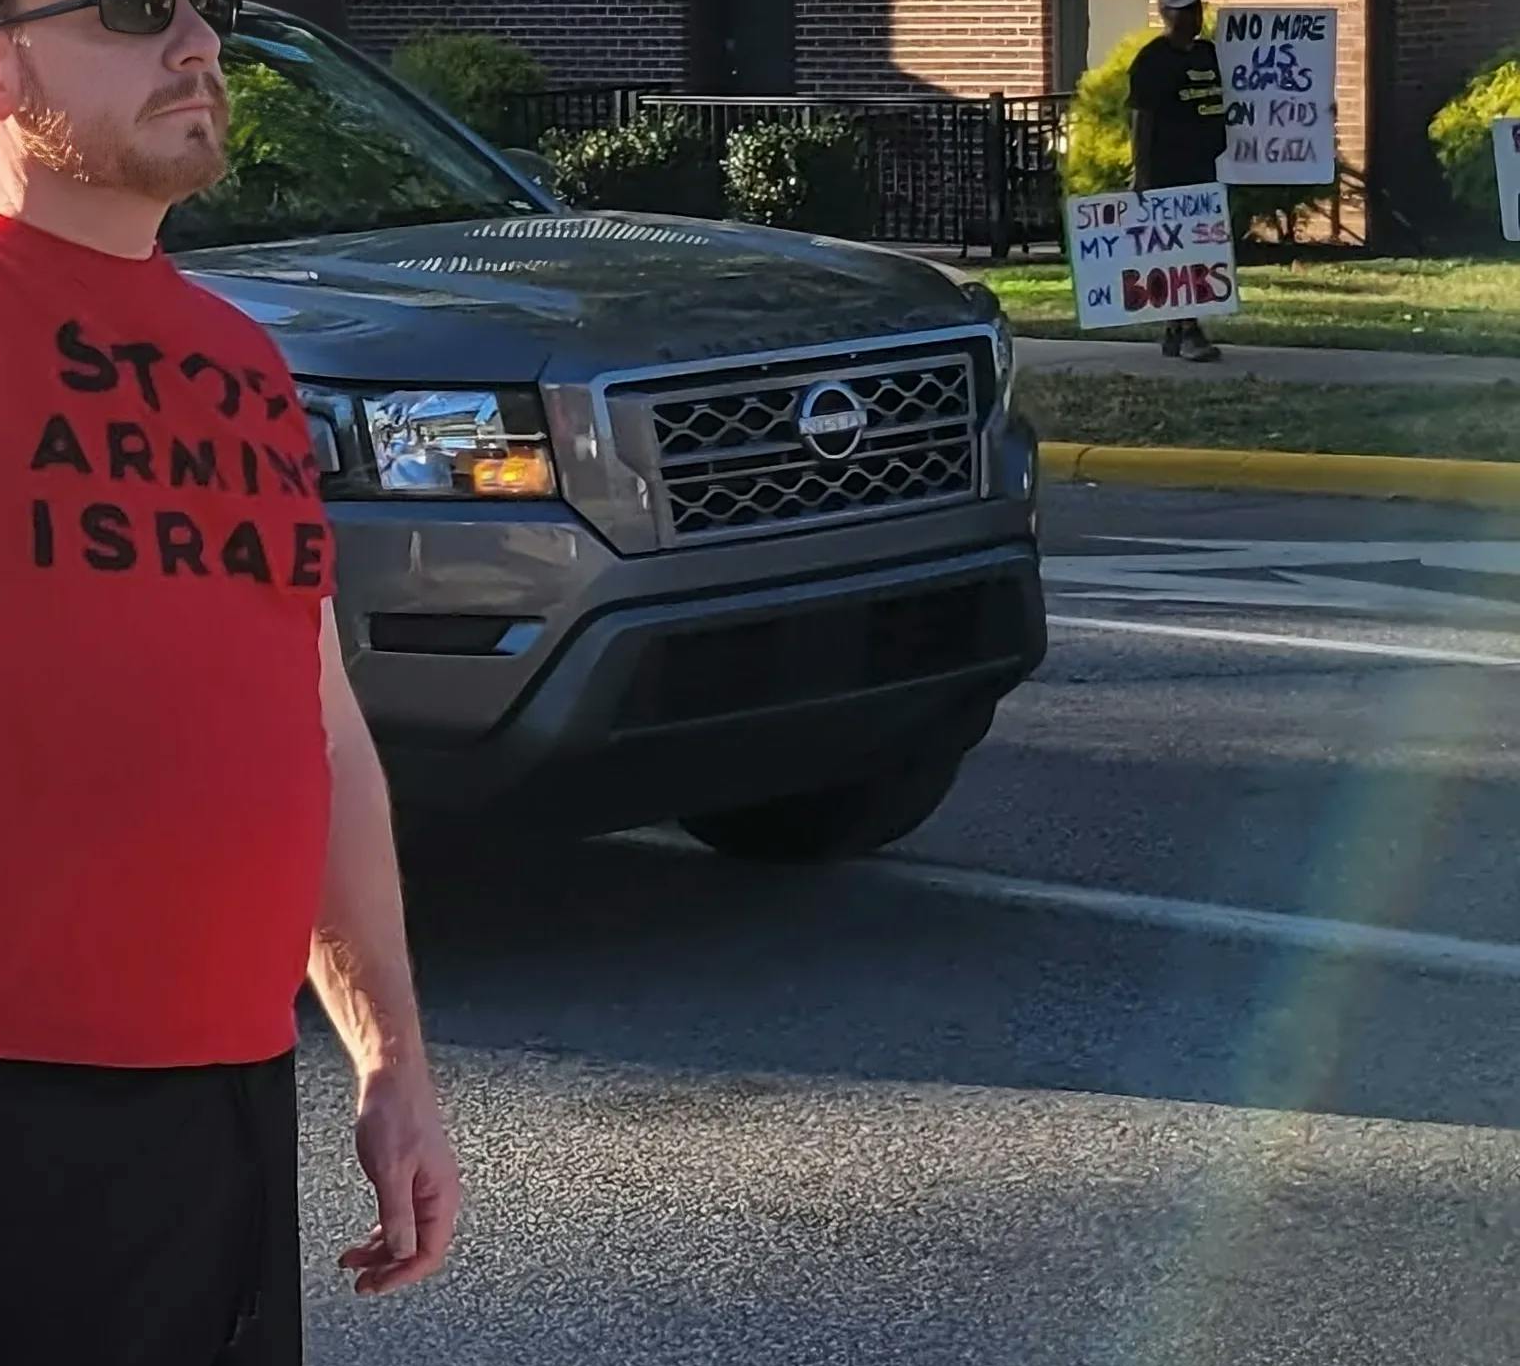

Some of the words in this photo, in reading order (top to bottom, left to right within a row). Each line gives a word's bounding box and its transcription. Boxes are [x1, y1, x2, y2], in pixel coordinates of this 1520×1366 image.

[1226, 14, 1262, 41] NO
[1271, 15, 1326, 41] MORE
[1252, 44, 1298, 68] US
[1232, 65, 1312, 92] BOMBS
[1226, 101, 1254, 126] ON
[1077, 201, 1127, 229] STOP
[1136, 192, 1222, 223] SPENDING
[1080, 236, 1117, 260] MY
[1128, 223, 1184, 256] TAX
[1122, 262, 1232, 312] BOMBS
